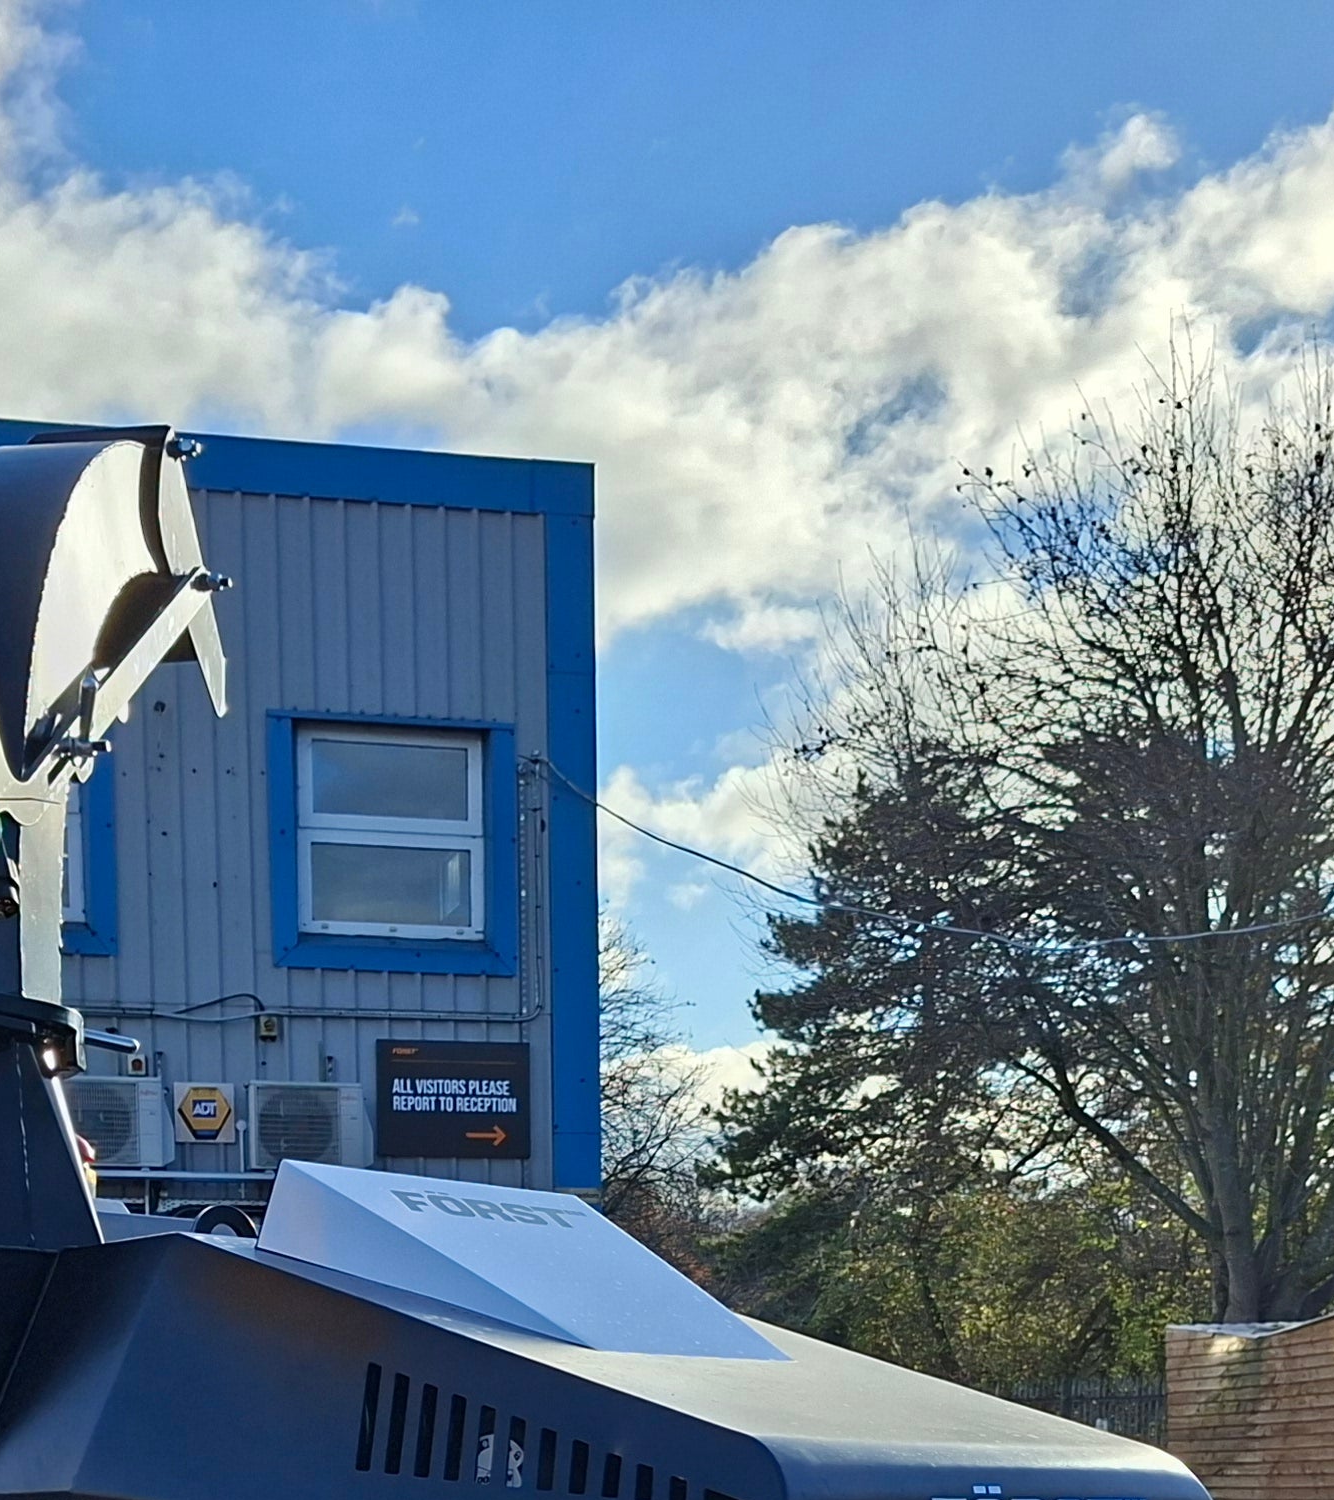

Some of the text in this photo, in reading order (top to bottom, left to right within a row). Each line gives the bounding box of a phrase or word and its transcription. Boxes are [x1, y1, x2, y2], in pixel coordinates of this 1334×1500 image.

[392, 1078, 511, 1096] ALL VISITORS PLEASE
[192, 1101, 218, 1116] ADT
[393, 1096, 517, 1113] REPORT TO RECEPTION
[390, 1189, 587, 1229] FÖRST
